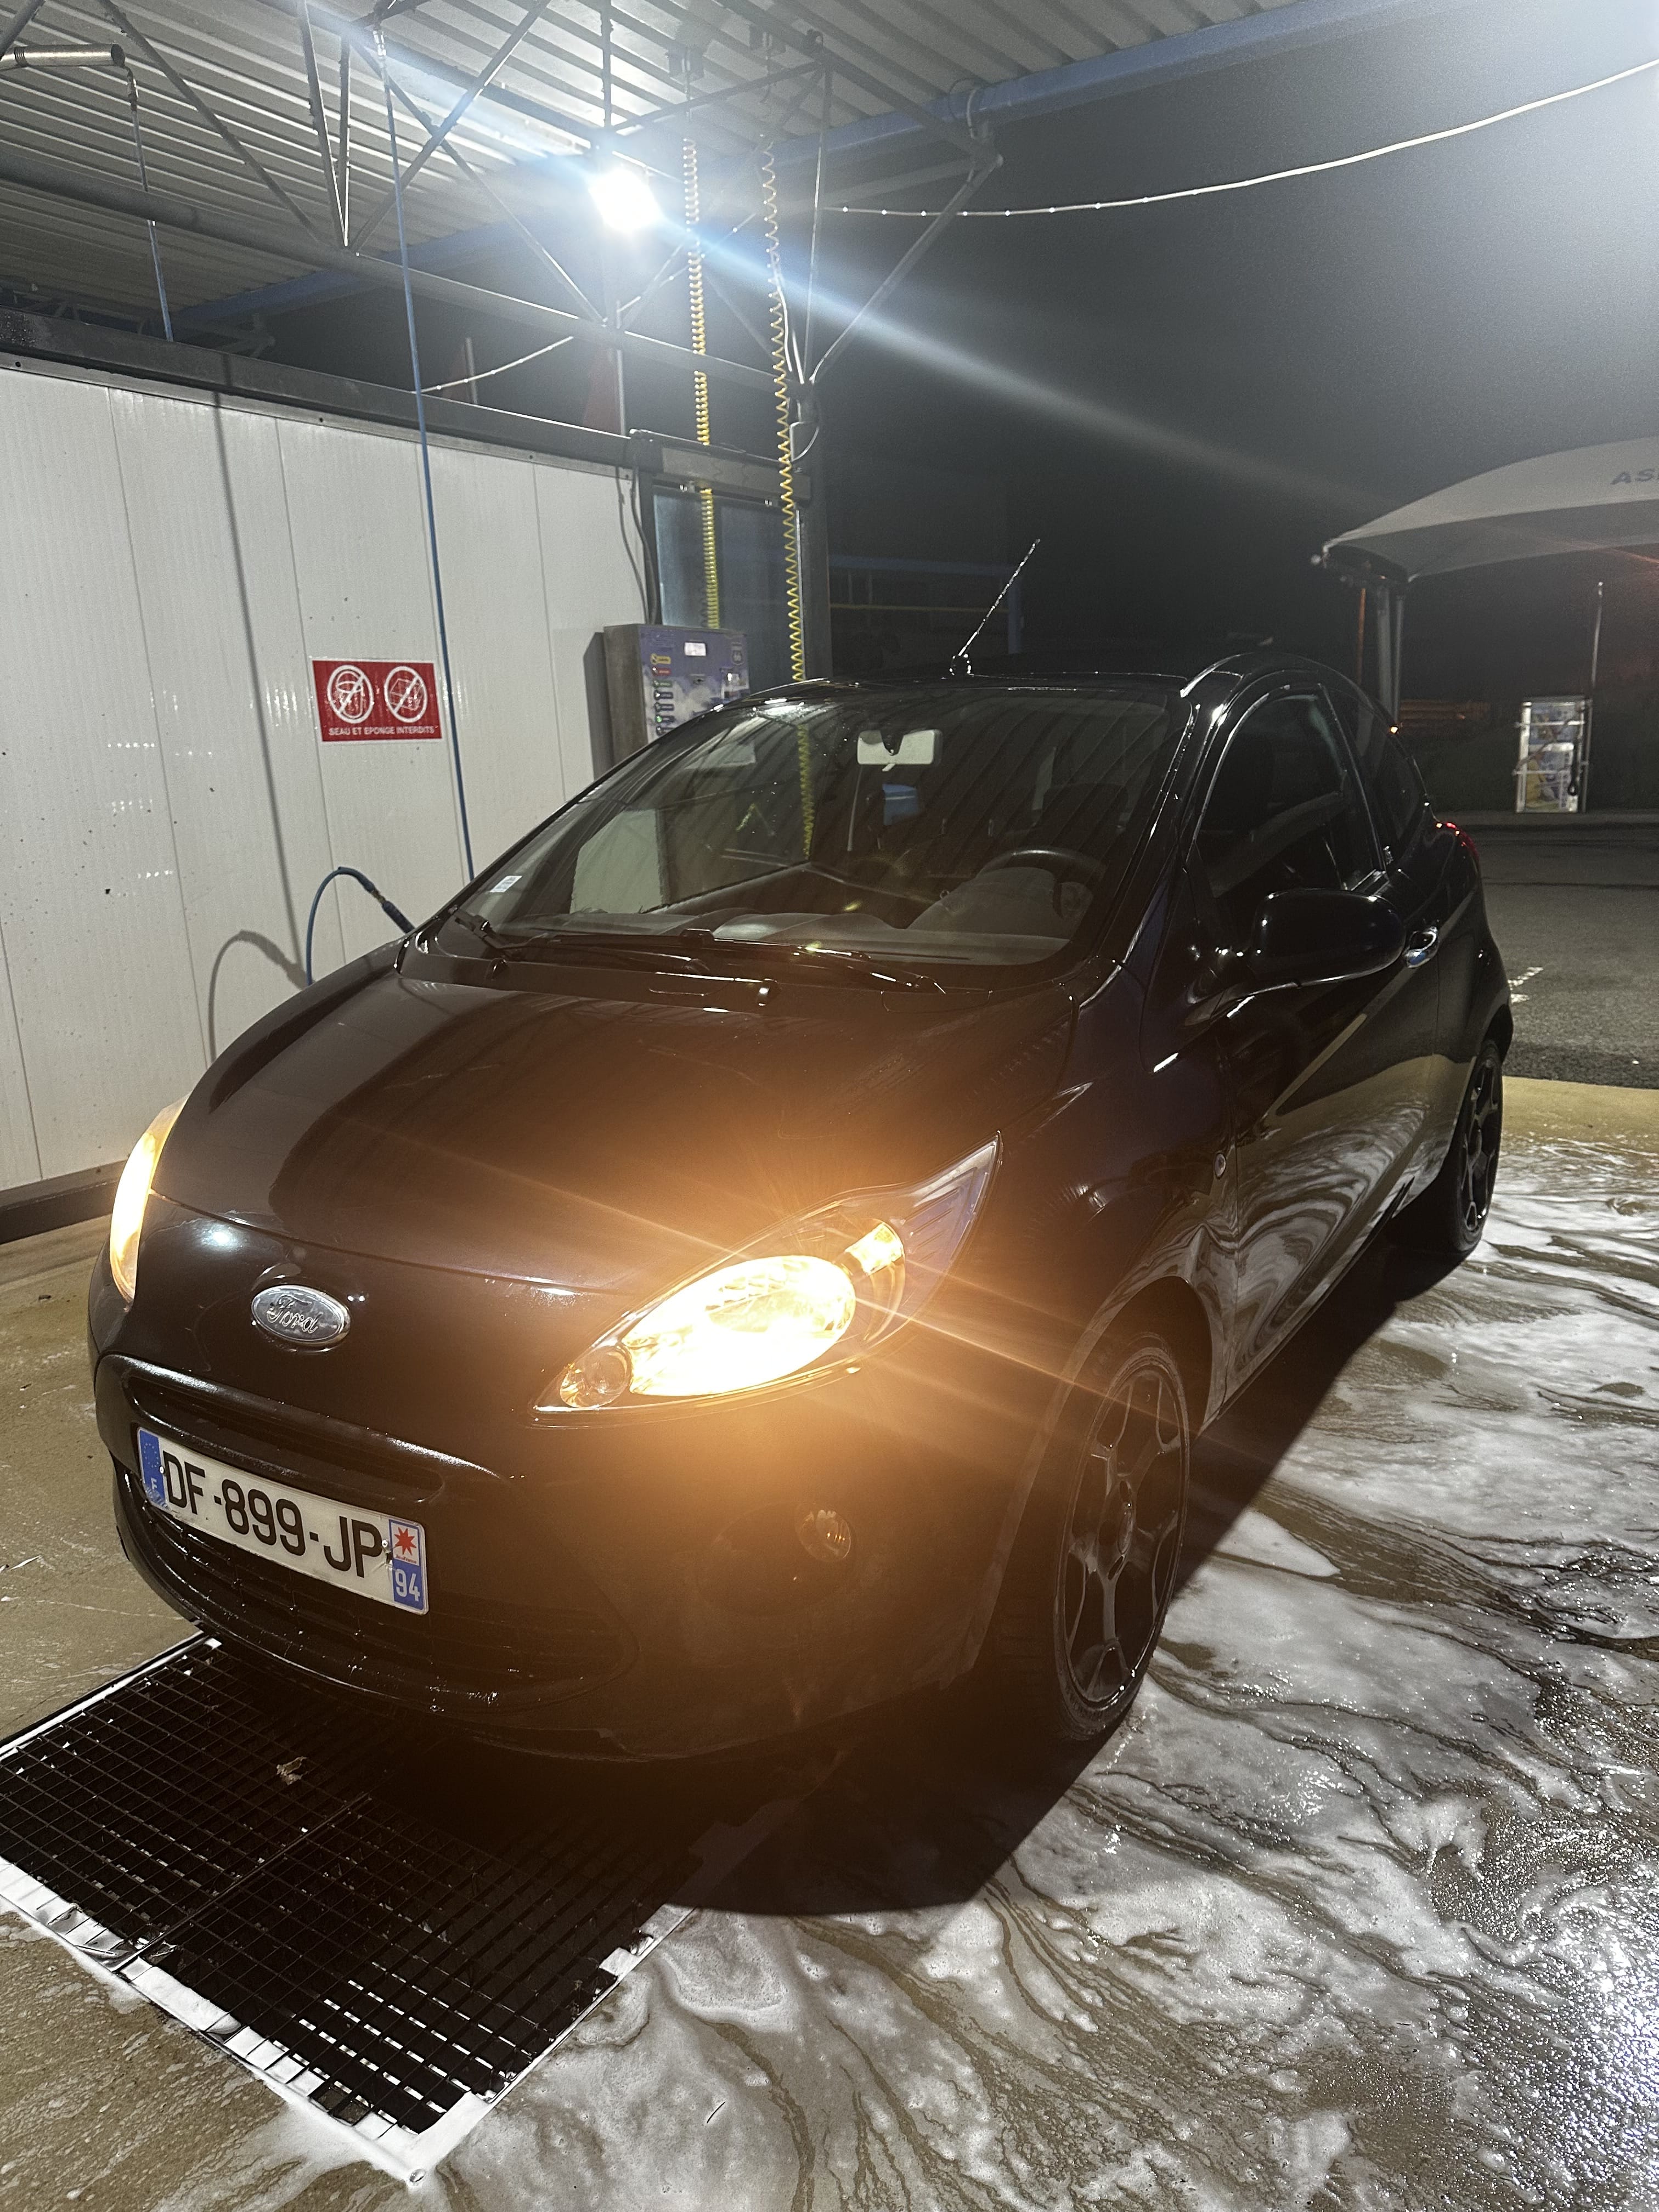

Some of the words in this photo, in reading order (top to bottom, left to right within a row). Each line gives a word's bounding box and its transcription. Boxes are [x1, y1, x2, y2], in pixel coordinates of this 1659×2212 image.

[1610, 468, 1659, 485] AS
[329, 727, 351, 736] SEAU
[352, 727, 362, 735] ET
[364, 726, 396, 735] EPONGE
[396, 725, 435, 734] INTERDITS
[267, 1294, 324, 1334] Ford
[151, 1477, 157, 1490] F
[163, 1450, 382, 1578] DF-899-JP
[395, 1568, 420, 1602] 94
